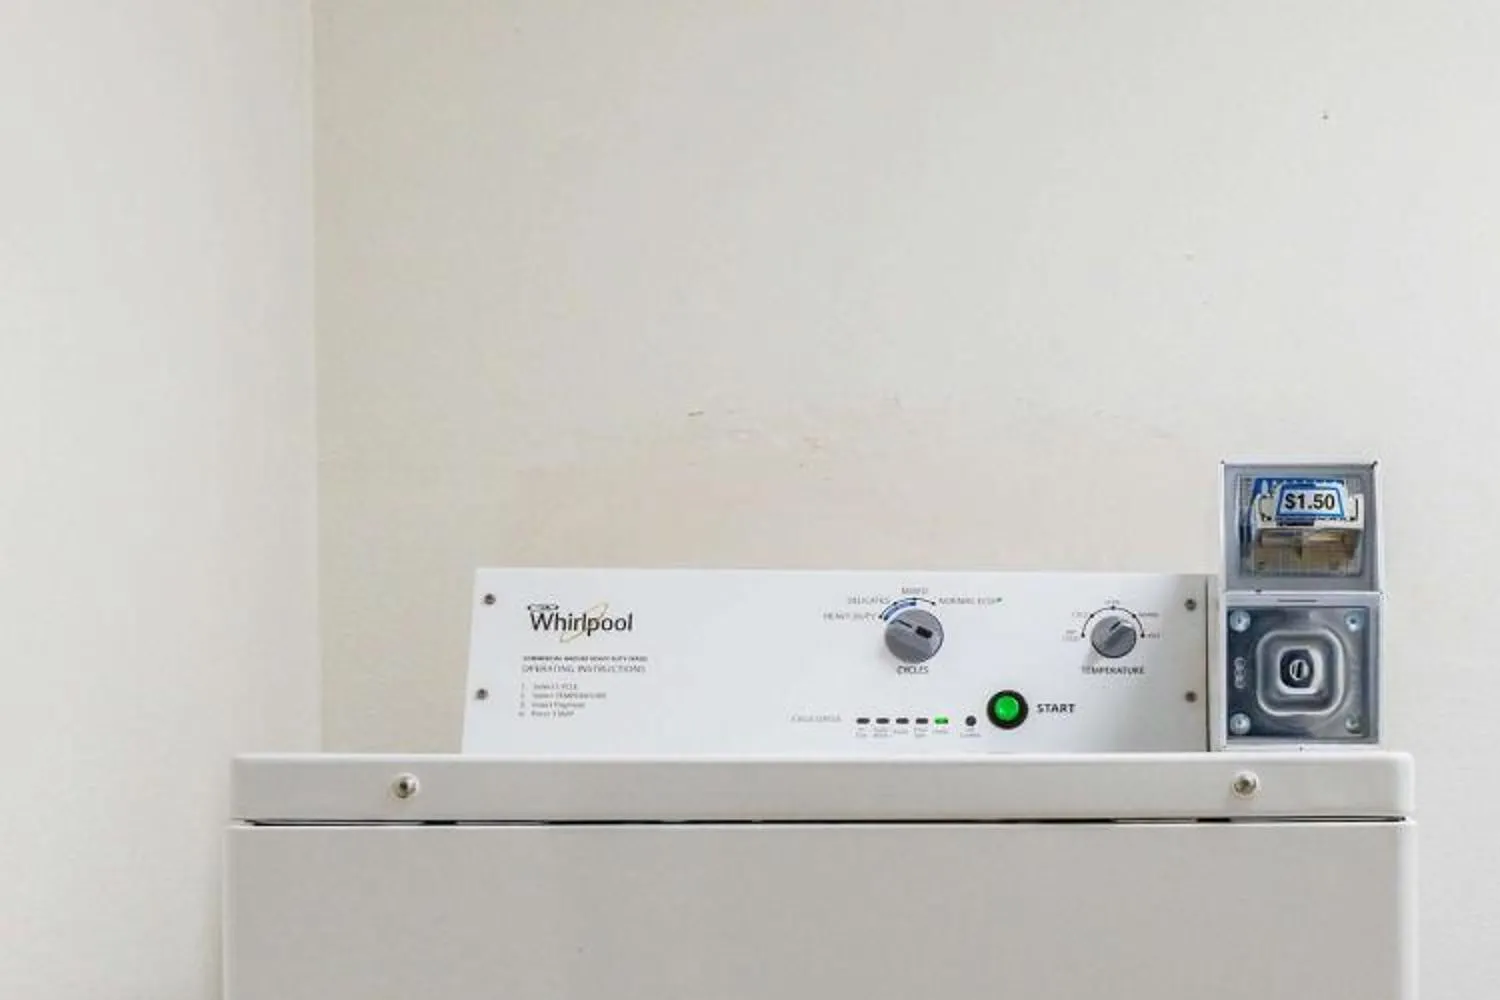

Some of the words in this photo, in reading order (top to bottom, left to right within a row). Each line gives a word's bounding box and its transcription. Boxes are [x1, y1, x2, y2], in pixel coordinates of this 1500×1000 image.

[1285, 493, 1335, 510] $1.50
[529, 612, 633, 636] Whirlpool
[896, 665, 929, 675] CYCLES
[1081, 666, 1145, 675] TEMPERATURE
[1037, 703, 1076, 714] START
